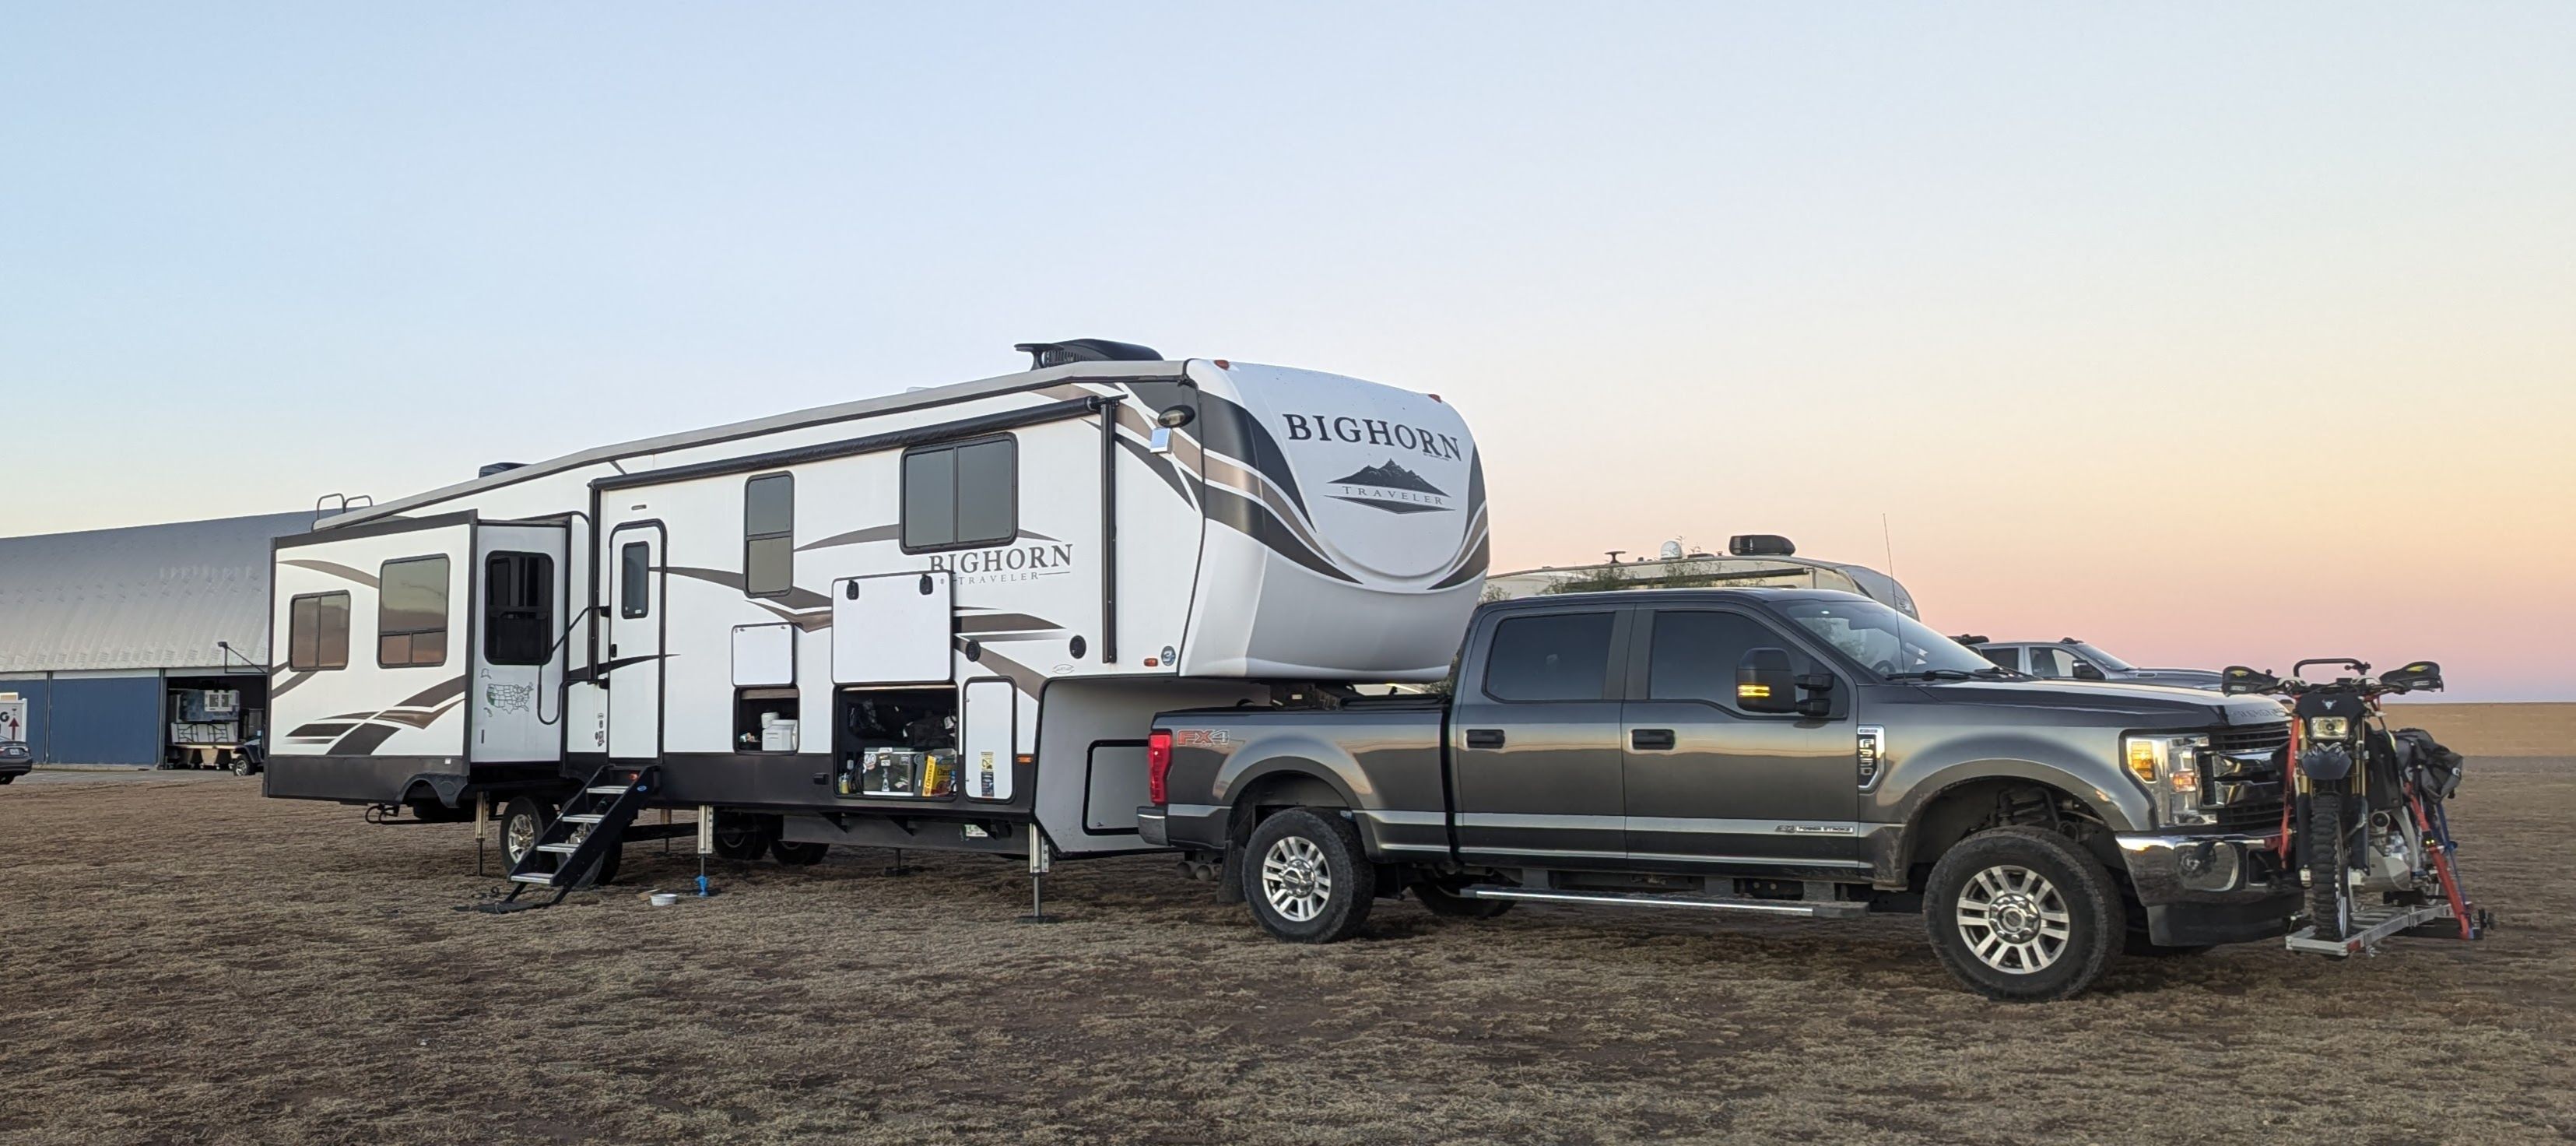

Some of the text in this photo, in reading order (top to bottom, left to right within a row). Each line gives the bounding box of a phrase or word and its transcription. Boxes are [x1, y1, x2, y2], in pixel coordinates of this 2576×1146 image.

[1283, 413, 1462, 462] BIGHORN
[1342, 485, 1443, 505] TRAVELER
[929, 544, 1073, 574] BIGHORN
[958, 571, 1039, 585] TRAVELER
[1177, 729, 1230, 746] FX4
